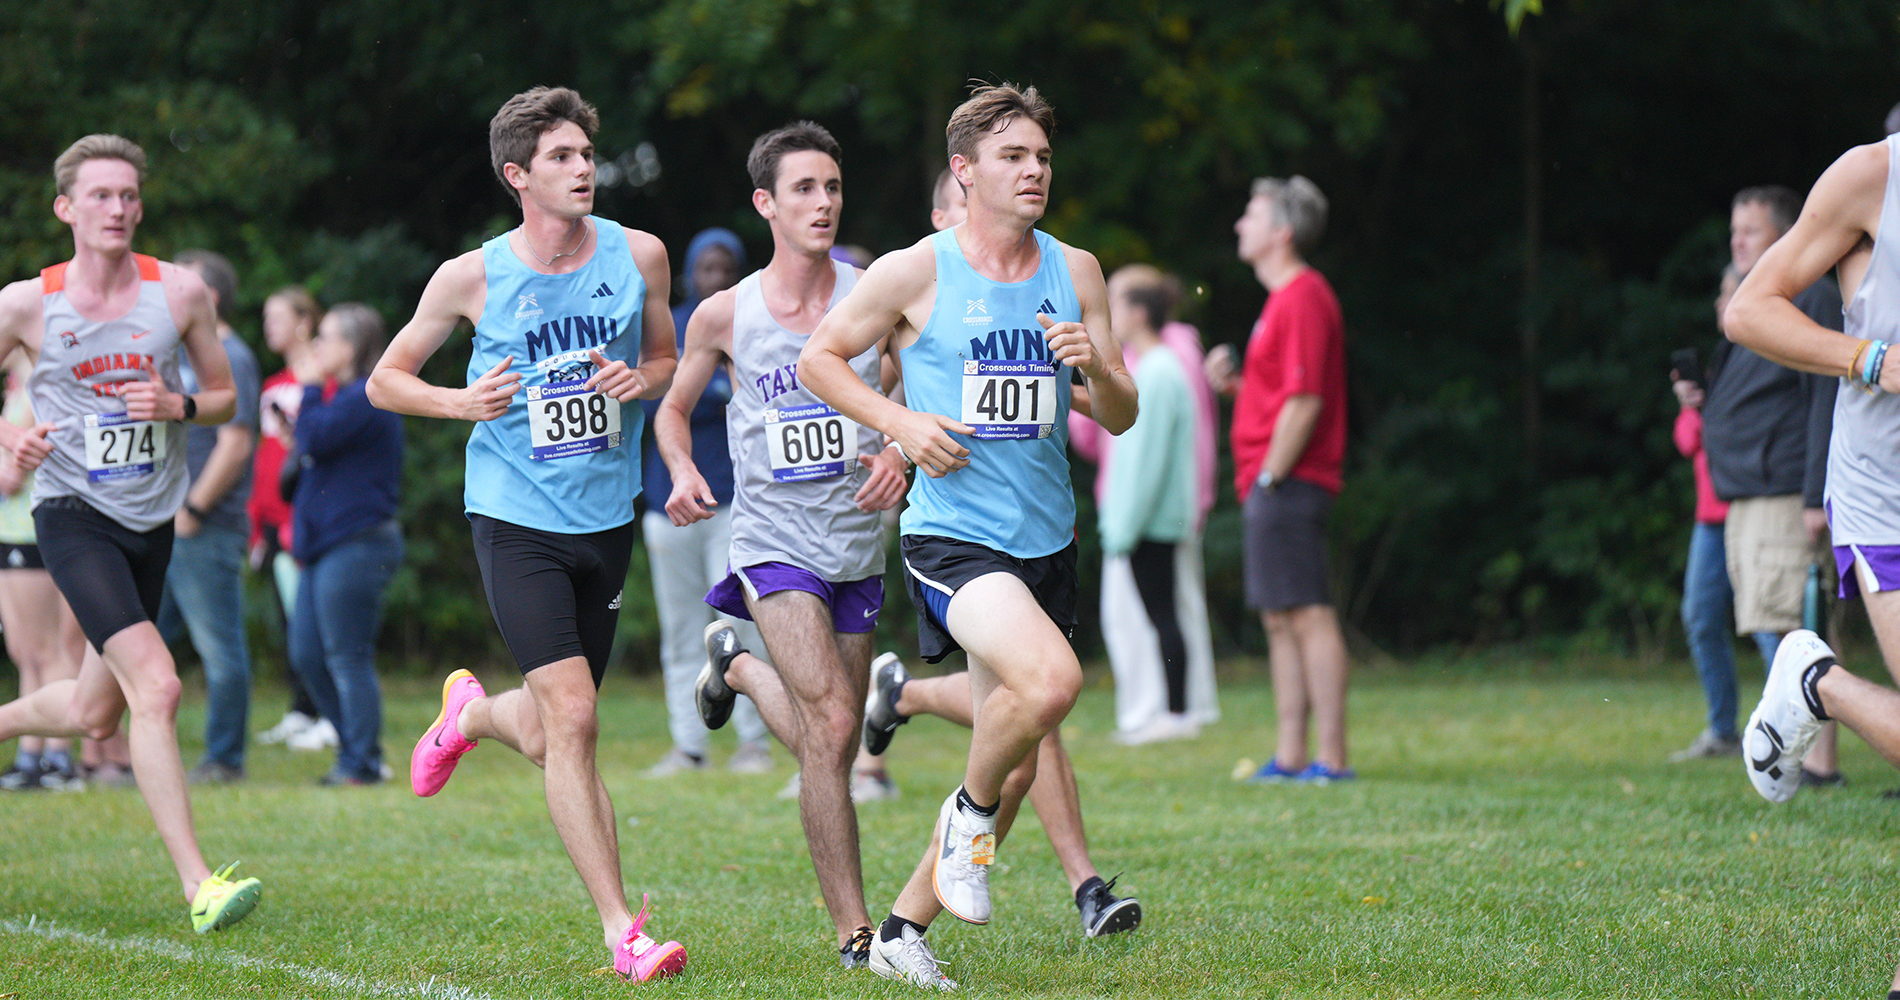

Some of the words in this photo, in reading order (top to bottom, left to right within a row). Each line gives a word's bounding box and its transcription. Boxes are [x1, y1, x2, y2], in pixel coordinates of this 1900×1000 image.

[525, 315, 617, 364] MVNU
[544, 347, 604, 367] COUGAS
[979, 363, 1027, 372] Crossroads
[1029, 364, 1055, 374] Timing
[541, 384, 587, 396] Crossroad
[976, 378, 1039, 422] 401
[544, 393, 608, 442] 398
[779, 406, 826, 419] Crossroads
[100, 425, 155, 464] 274
[567, 442, 584, 450] Results
[781, 419, 845, 464] 609
